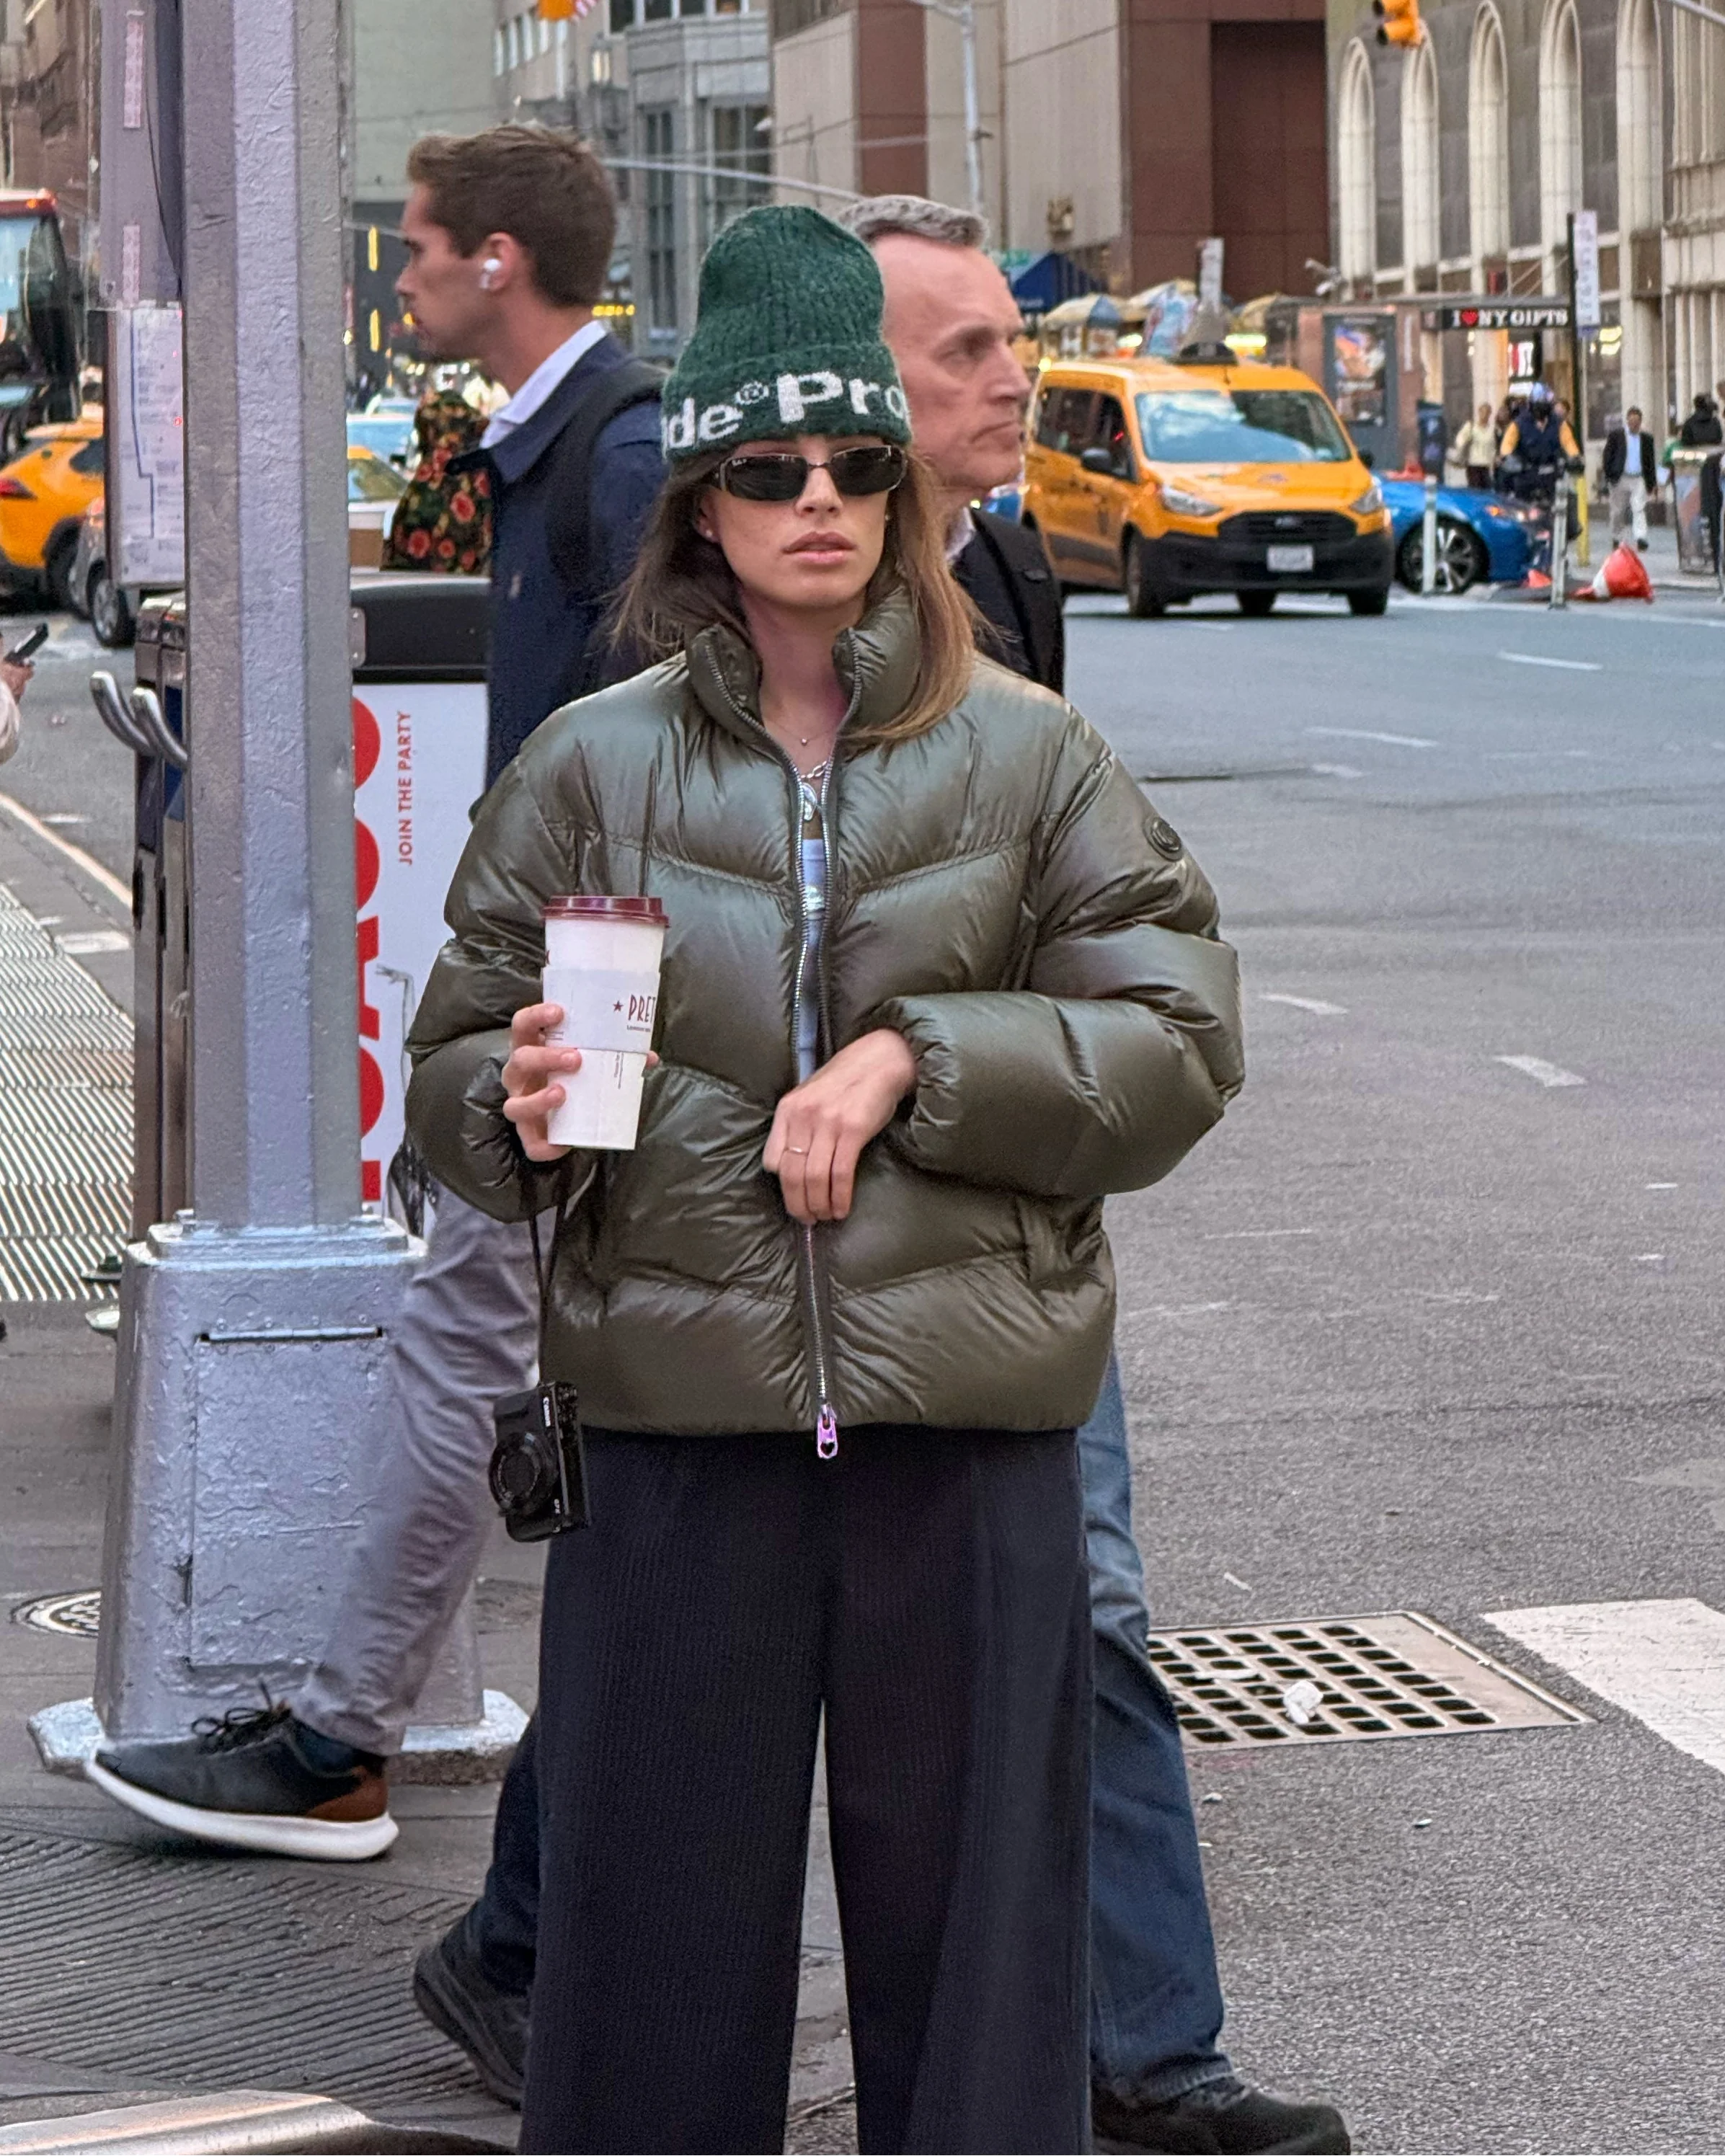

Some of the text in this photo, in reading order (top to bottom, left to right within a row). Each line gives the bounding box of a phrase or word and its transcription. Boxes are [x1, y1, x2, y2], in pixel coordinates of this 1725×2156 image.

[1478, 309, 1508, 326] NY
[1510, 309, 1569, 326] GIFTS
[397, 710, 413, 866] JOIN THE PARTY
